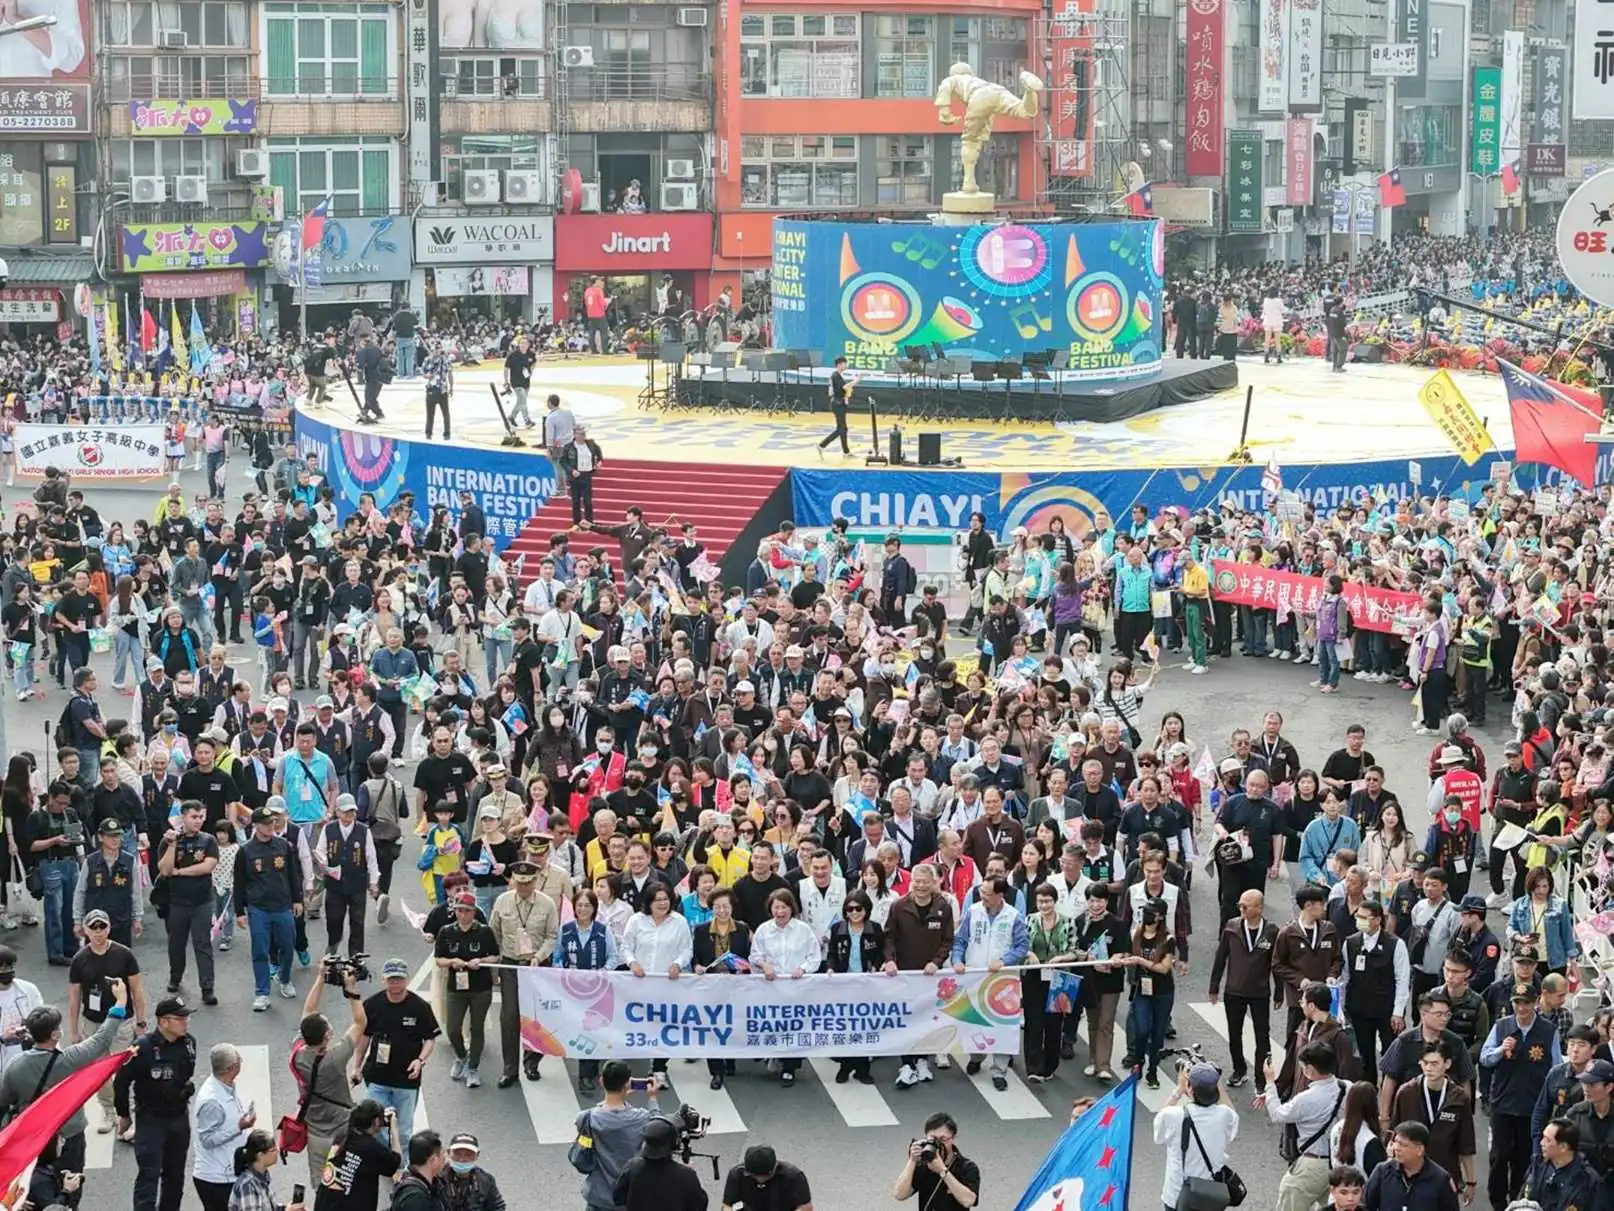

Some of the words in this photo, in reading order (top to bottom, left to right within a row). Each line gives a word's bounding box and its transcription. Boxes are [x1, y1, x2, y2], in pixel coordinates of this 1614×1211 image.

[464, 224, 542, 240] WACOAL
[602, 232, 671, 252] Jinart
[1070, 341, 1113, 354] BAND
[1070, 352, 1134, 369] FESTIVAL
[427, 465, 557, 498] INTERNATION
[831, 491, 982, 527] CHIAYI
[625, 1002, 733, 1025] CHIAYI
[746, 1002, 912, 1019] INTERNATIONAL
[746, 1018, 804, 1032] BAND
[811, 1016, 907, 1031] FESTIVAL
[625, 1032, 657, 1047] 33rd
[660, 1025, 733, 1047] CITY
[746, 1031, 881, 1047] 嘉義市國際管樂節
